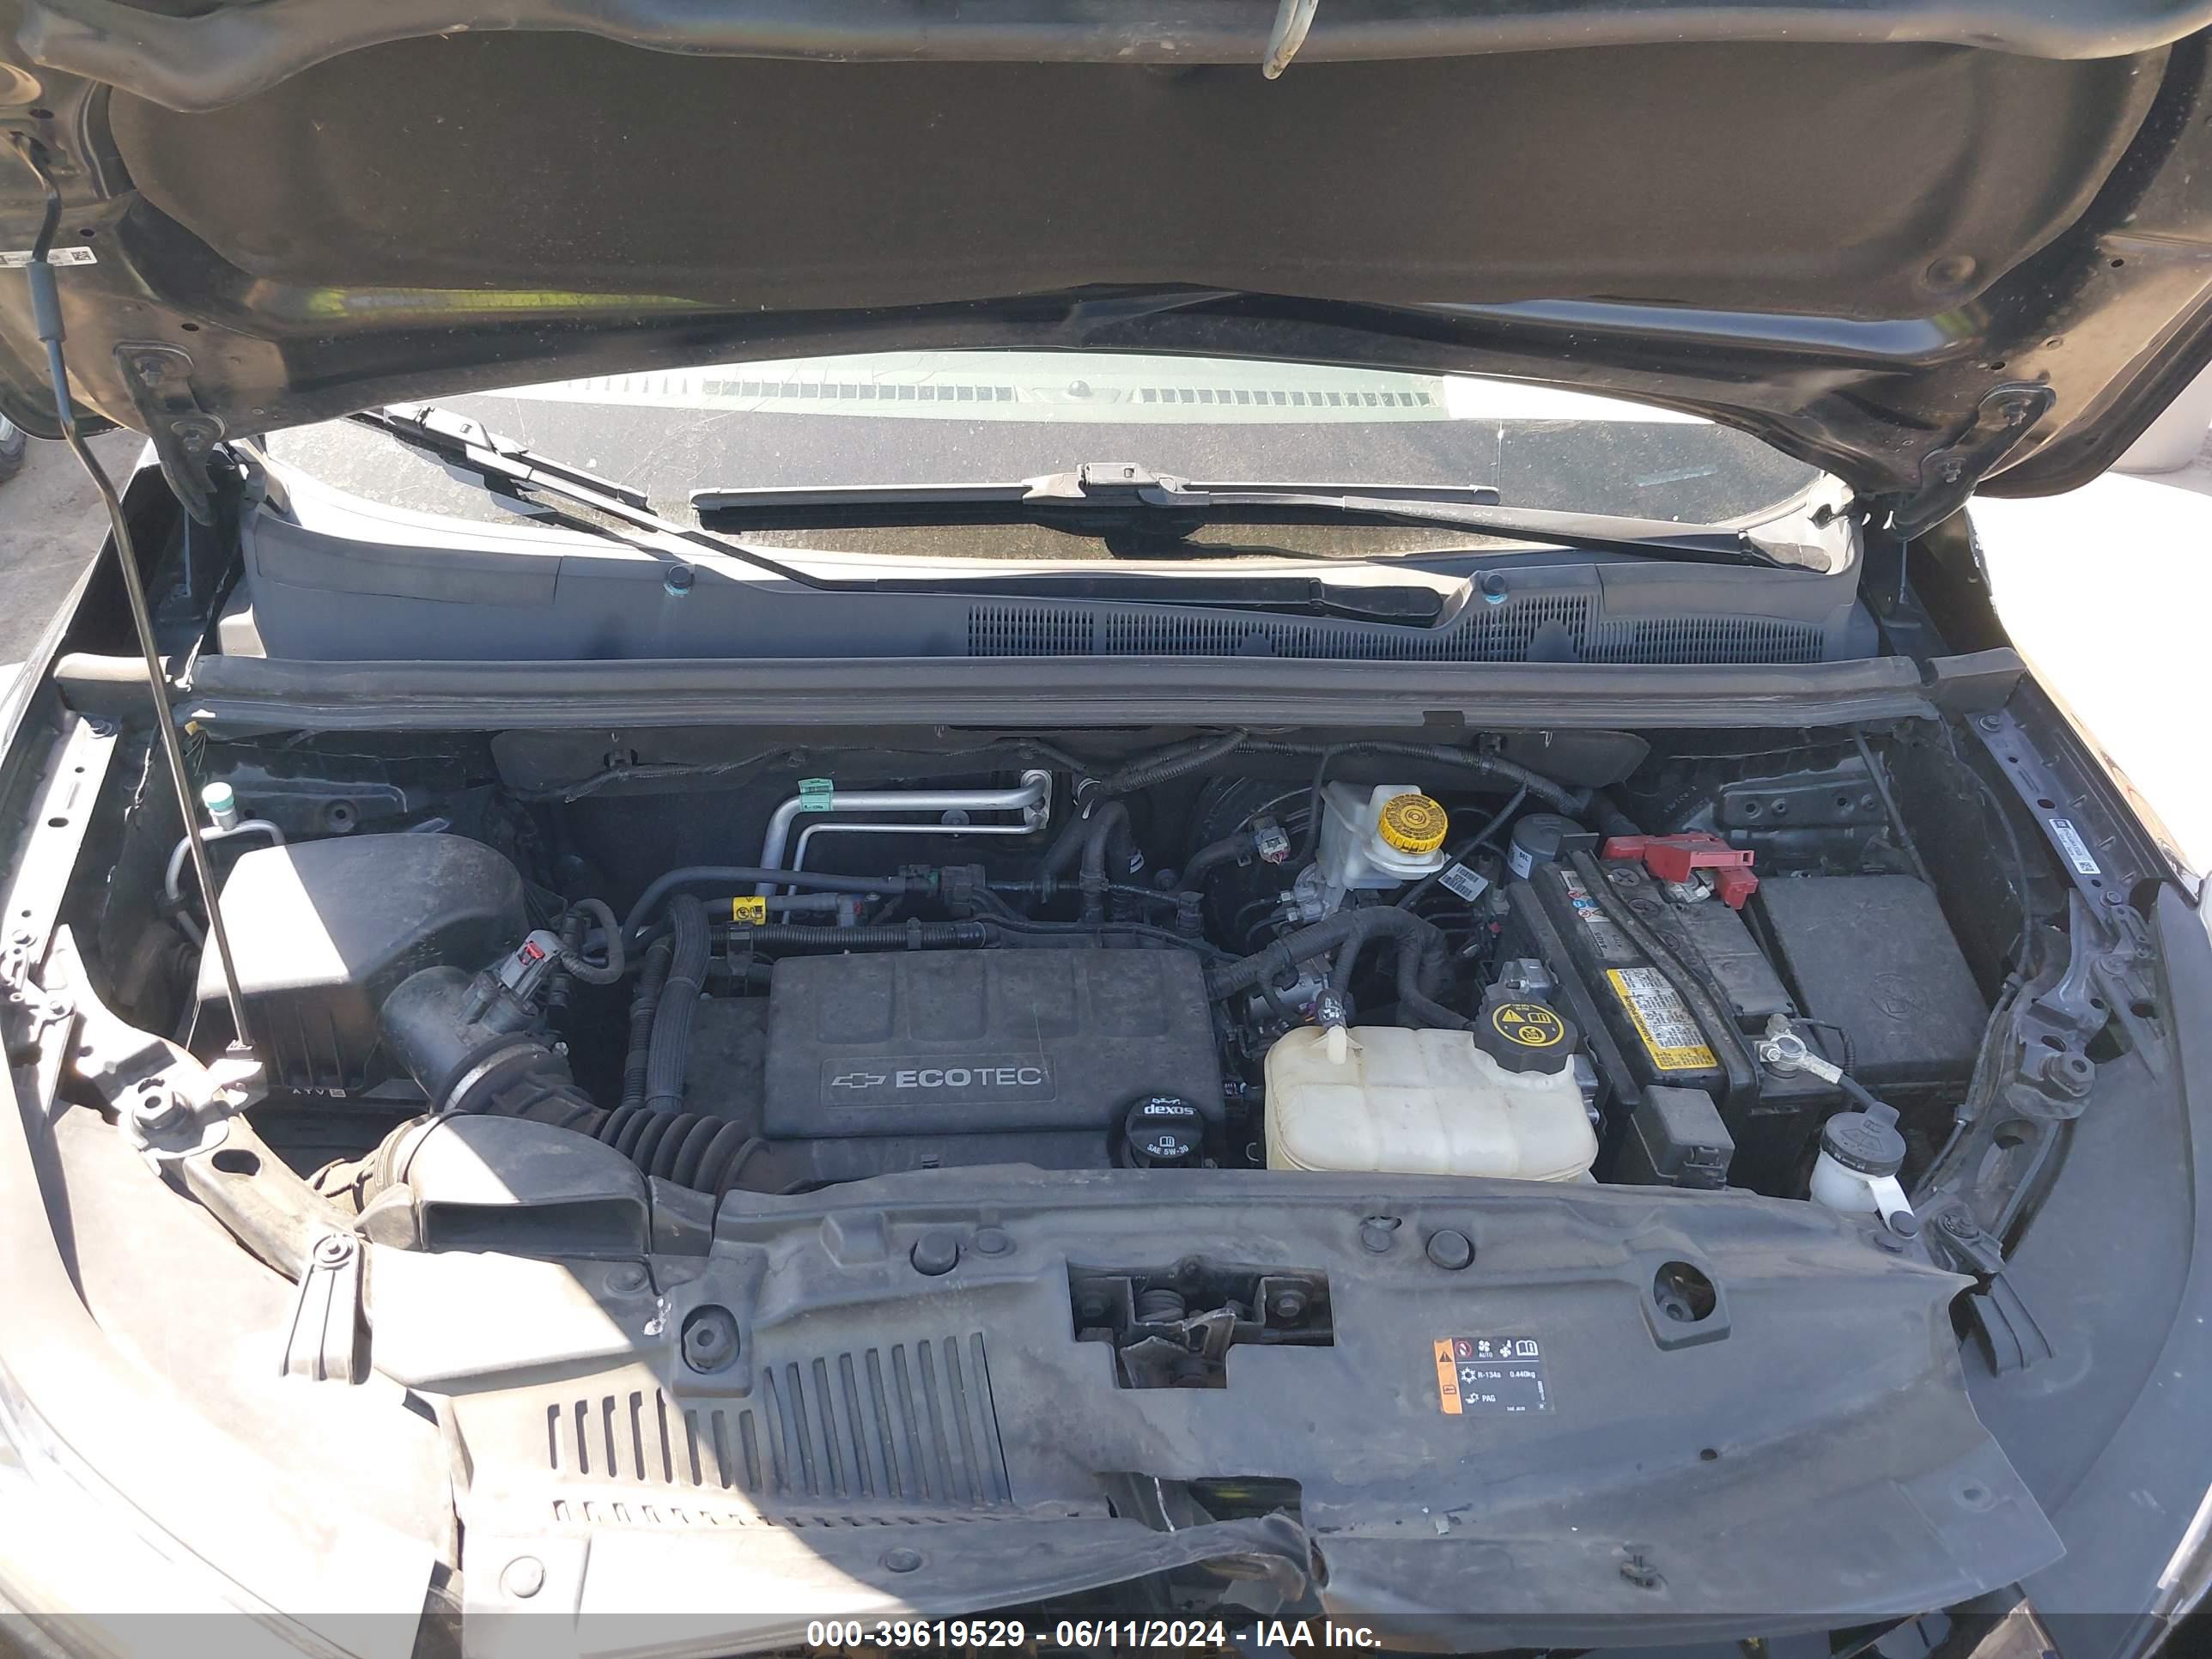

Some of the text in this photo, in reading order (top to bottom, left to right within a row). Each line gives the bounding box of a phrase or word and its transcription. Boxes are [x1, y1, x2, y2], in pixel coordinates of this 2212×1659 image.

[896, 1067, 1042, 1088] ECOTEC
[1144, 1104, 1195, 1115] dexos
[1147, 1144, 1189, 1155] SAE 5W-30
